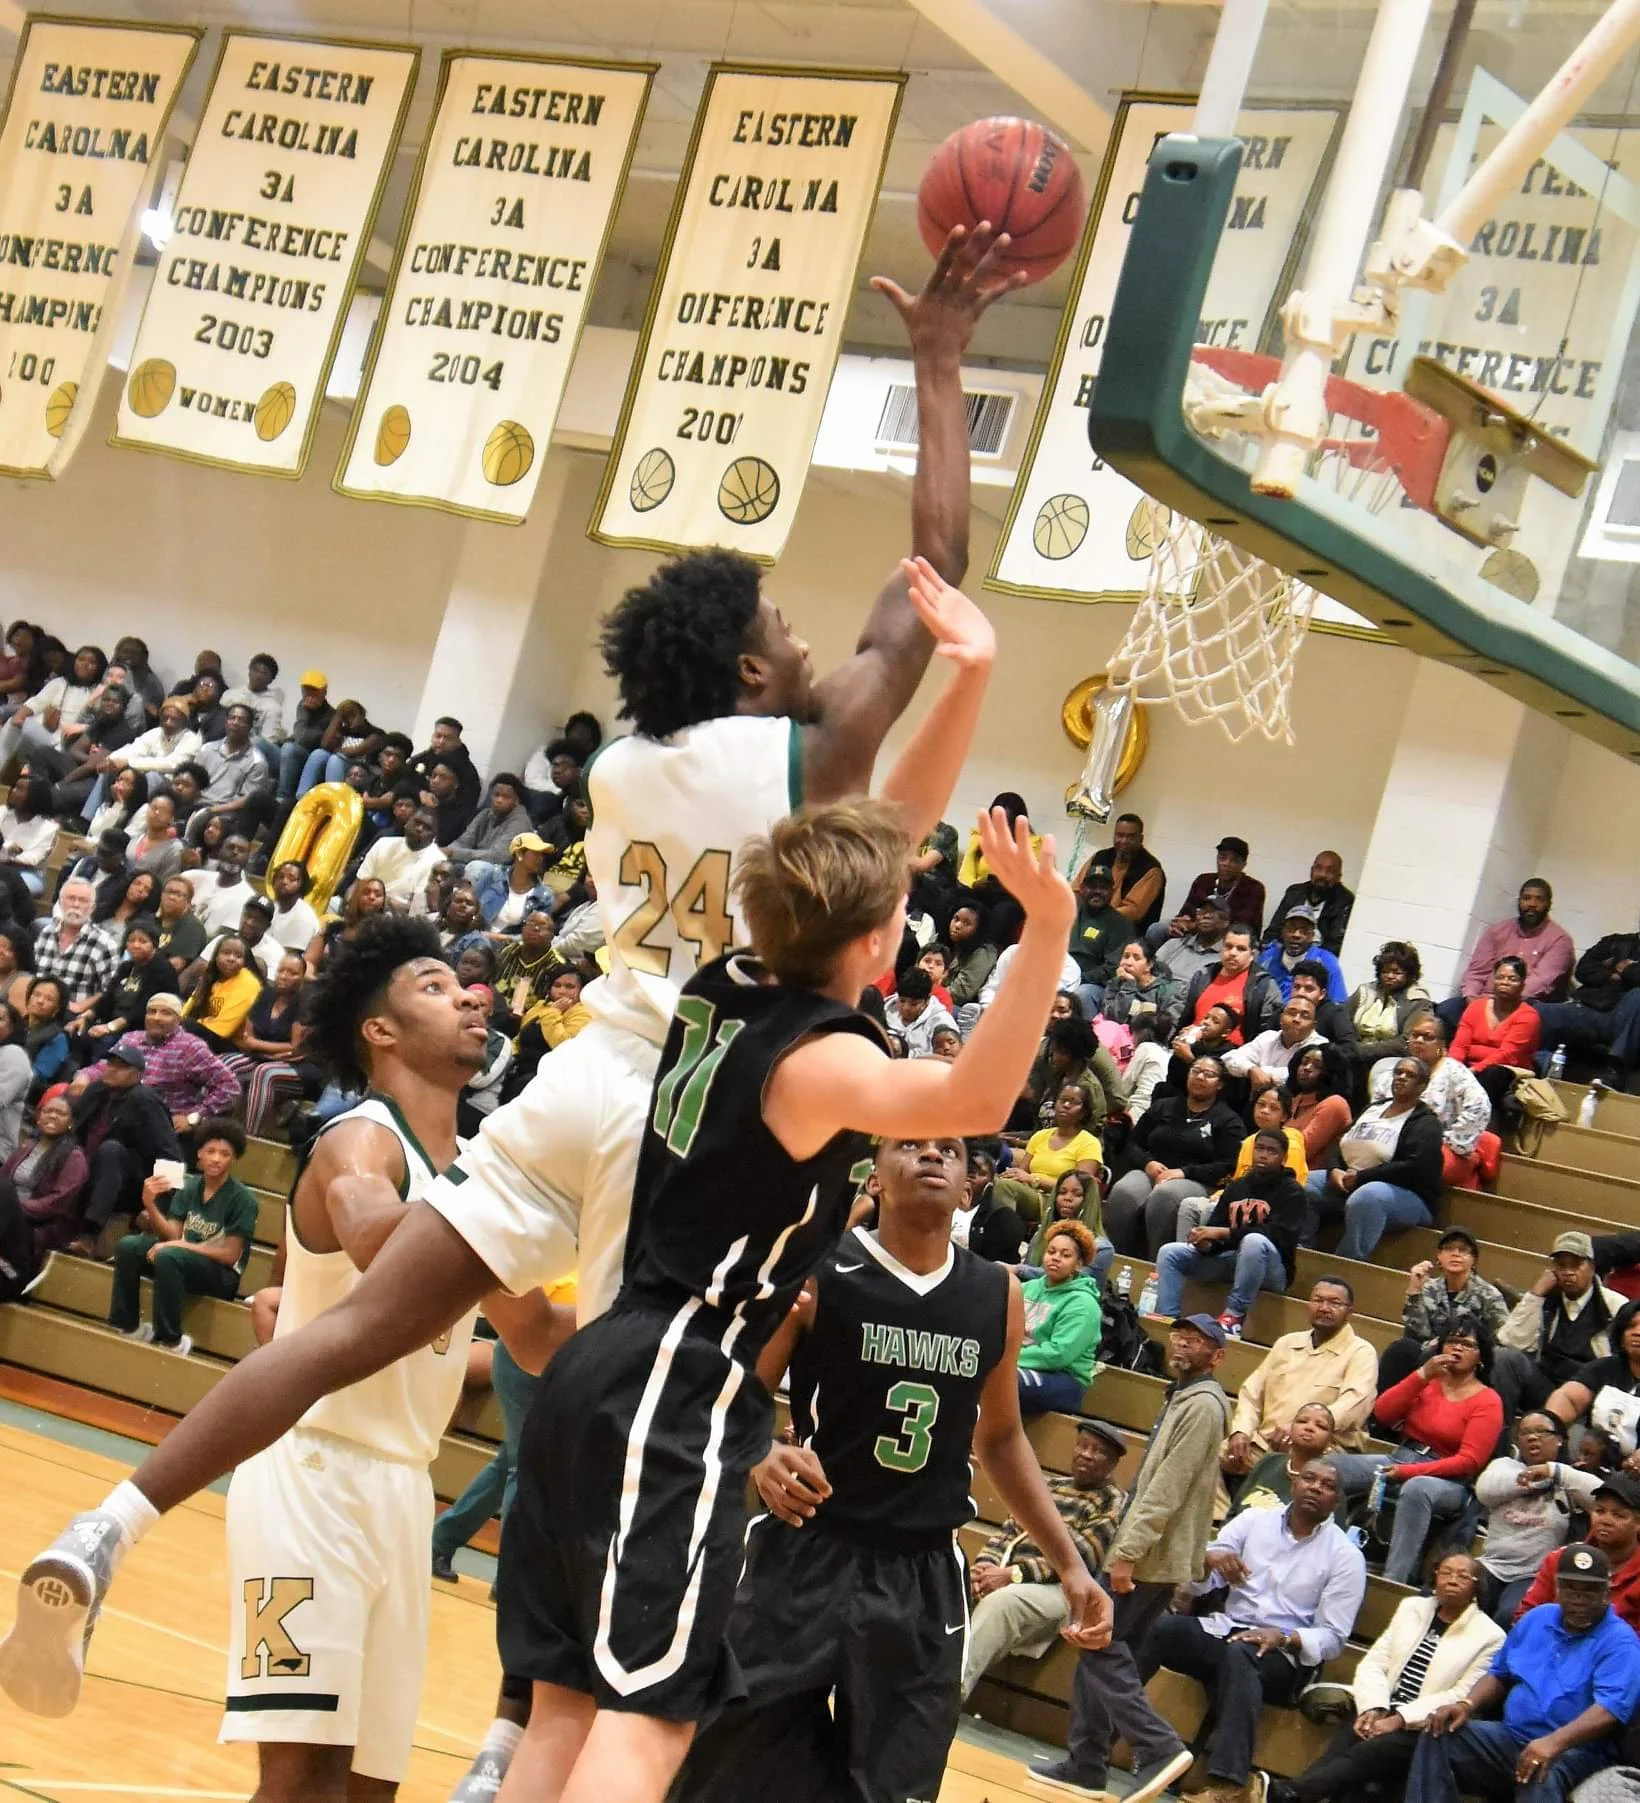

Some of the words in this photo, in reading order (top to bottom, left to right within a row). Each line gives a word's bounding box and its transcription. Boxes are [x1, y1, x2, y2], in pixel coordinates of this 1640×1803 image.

[40, 64, 160, 104] EASTERN
[245, 62, 374, 106] EASTERN
[472, 84, 605, 126] EASTERN
[25, 120, 149, 164] CAROLNA
[221, 110, 358, 159] CAROLINA
[732, 110, 858, 148] EASTERN
[453, 137, 591, 182] CAROLINA
[55, 184, 93, 216] 3A
[260, 170, 294, 203] 3A
[709, 174, 838, 213] CAROLNA
[175, 207, 348, 262] CONFERENCE
[490, 197, 524, 230] 3A
[747, 237, 781, 272] 3A
[1470, 219, 1602, 265] ROLINA
[167, 258, 326, 312] CHAMPIONS
[410, 244, 587, 292] CONFERENCE
[405, 297, 563, 344] CHAMPIONS
[1475, 286, 1521, 325] 3A
[194, 314, 274, 359] 2003
[428, 352, 504, 391] 2004
[179, 387, 256, 423] WOMEN
[613, 840, 734, 977] 24
[653, 995, 746, 1159] 11
[861, 1322, 980, 1378] HAWKS
[873, 1380, 940, 1473] 3
[241, 1577, 314, 1680] K
